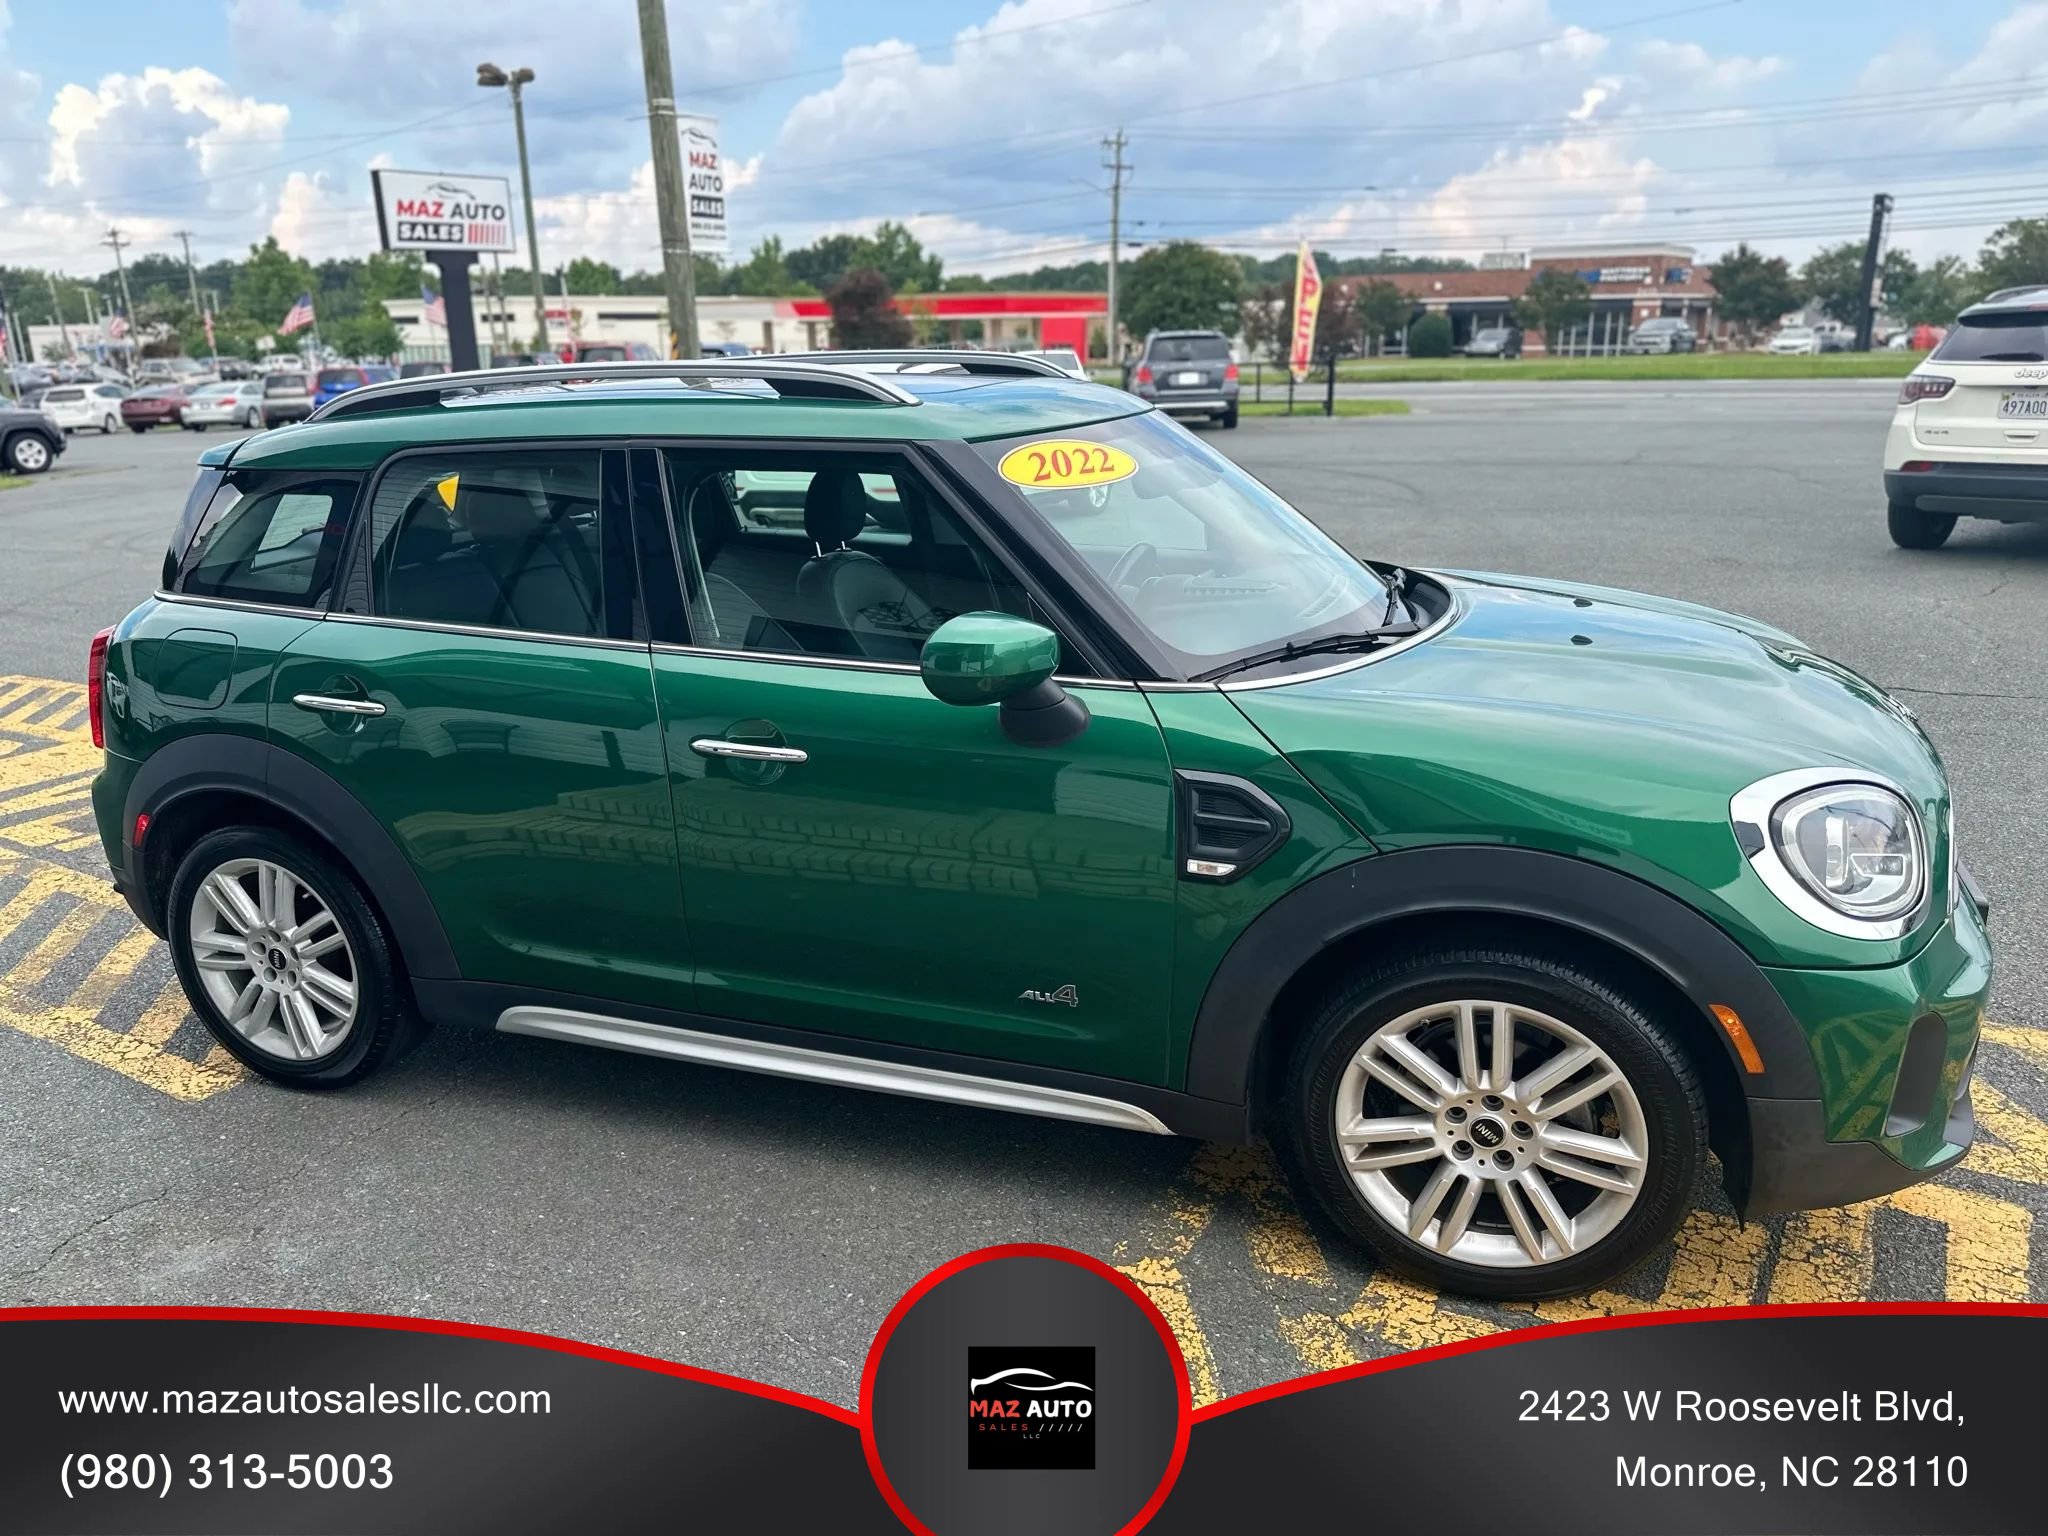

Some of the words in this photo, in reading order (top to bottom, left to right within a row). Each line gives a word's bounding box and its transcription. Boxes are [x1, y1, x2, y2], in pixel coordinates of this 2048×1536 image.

[688, 150, 718, 170] MAZ
[689, 173, 723, 192] AUTO
[396, 198, 444, 218] MAZ
[450, 203, 505, 221] AUTO
[400, 223, 463, 241] SALES
[2015, 368, 2048, 380] Jeep
[1028, 447, 1115, 482] 2022
[1475, 1123, 1500, 1144] MINI
